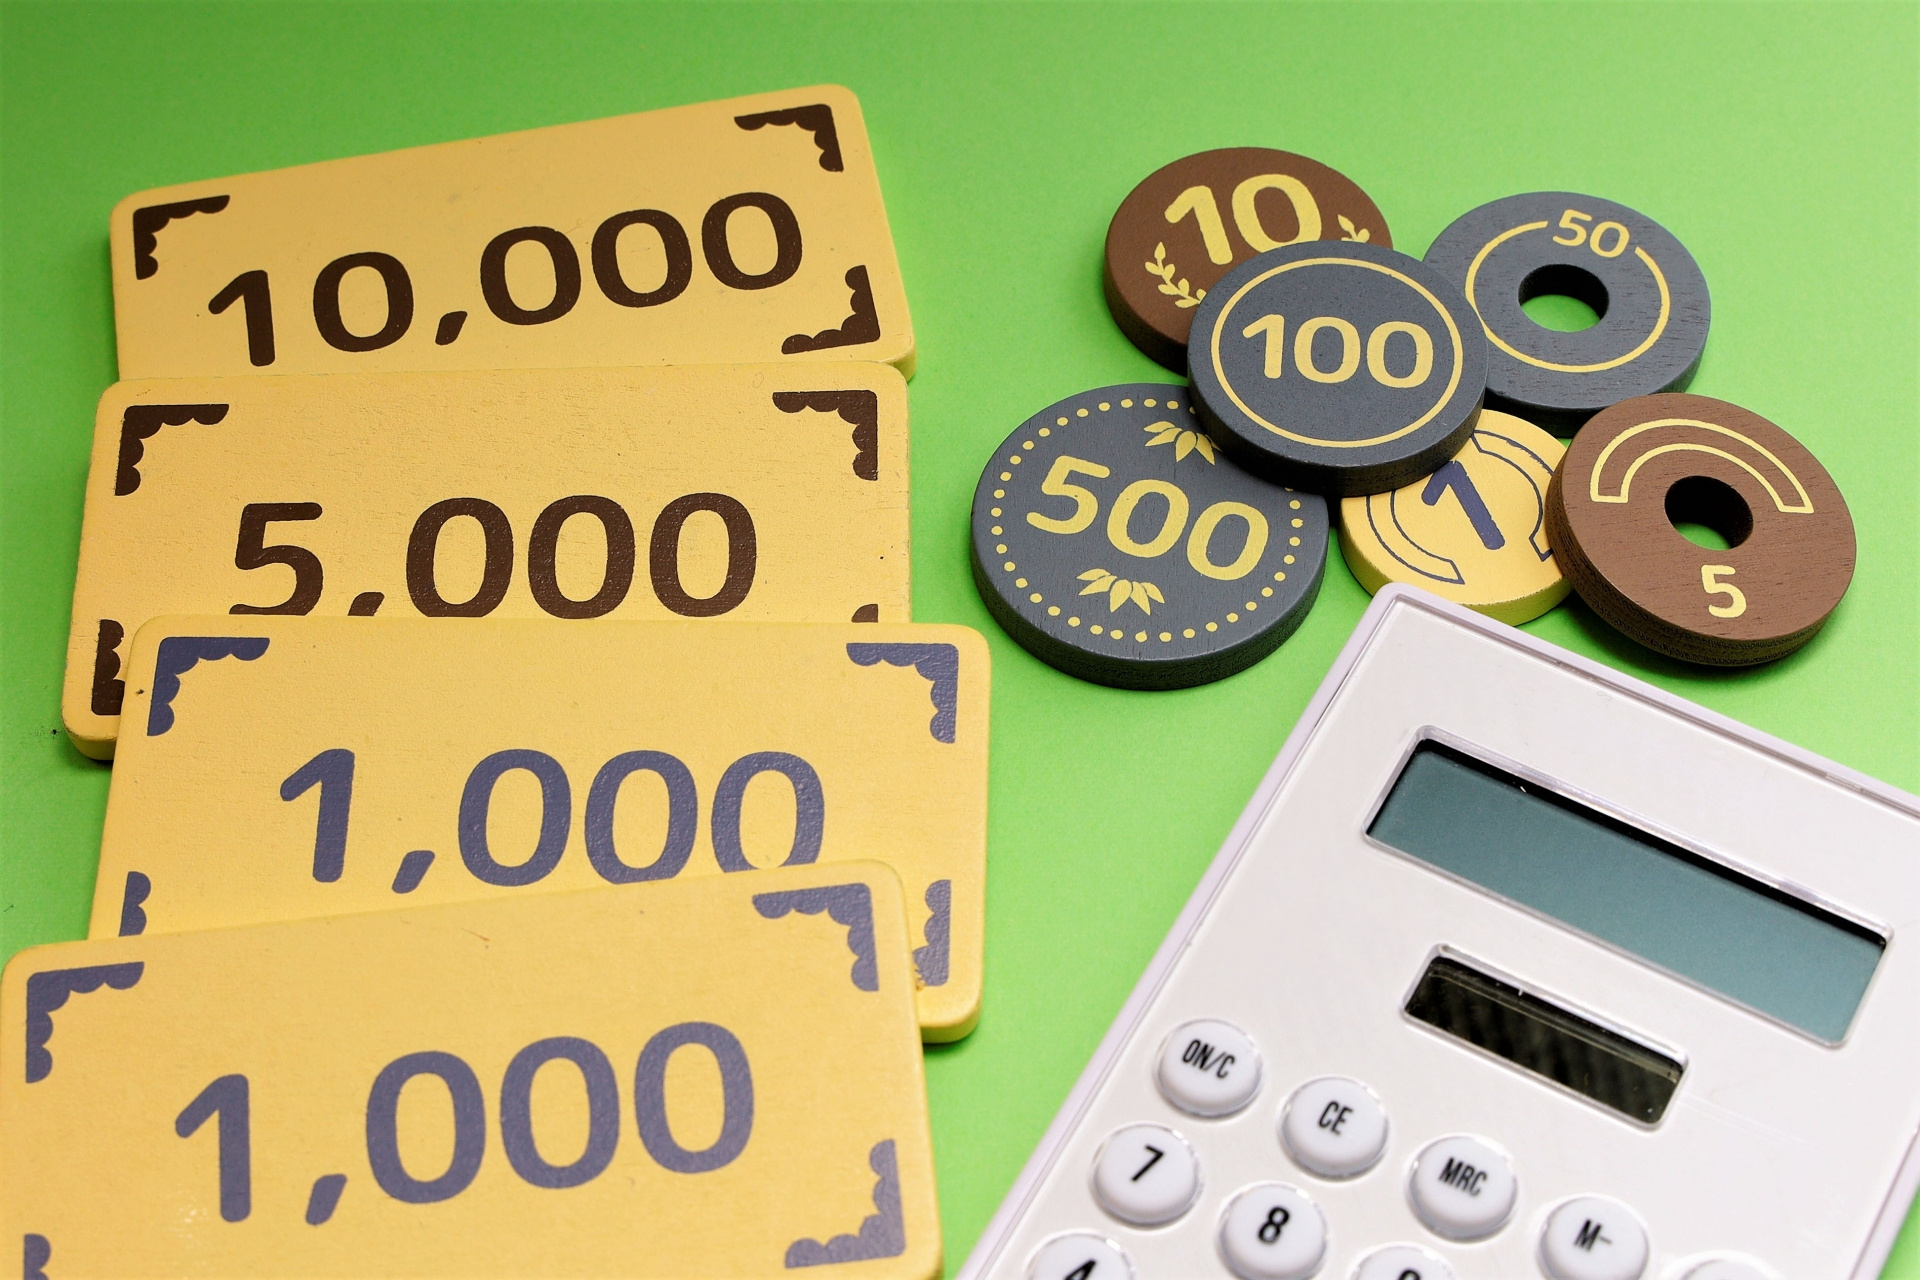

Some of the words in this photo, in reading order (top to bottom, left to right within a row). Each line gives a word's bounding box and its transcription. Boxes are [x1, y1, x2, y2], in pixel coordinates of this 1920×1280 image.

[1163, 173, 1323, 265] 10
[1552, 208, 1631, 259] 50
[208, 191, 803, 367] 10,000
[1242, 313, 1435, 388] 100
[1025, 455, 1270, 581] 500
[1421, 461, 1505, 550] 1
[229, 492, 757, 618] 5,000
[1700, 564, 1748, 619] 5
[280, 748, 826, 894] 1,000
[1182, 1039, 1236, 1079] ON/C
[175, 1022, 755, 1226] 1,000
[1318, 1100, 1353, 1135] CE
[1131, 1144, 1165, 1183] 7
[1438, 1157, 1488, 1197] MRC
[1257, 1206, 1291, 1244] 8
